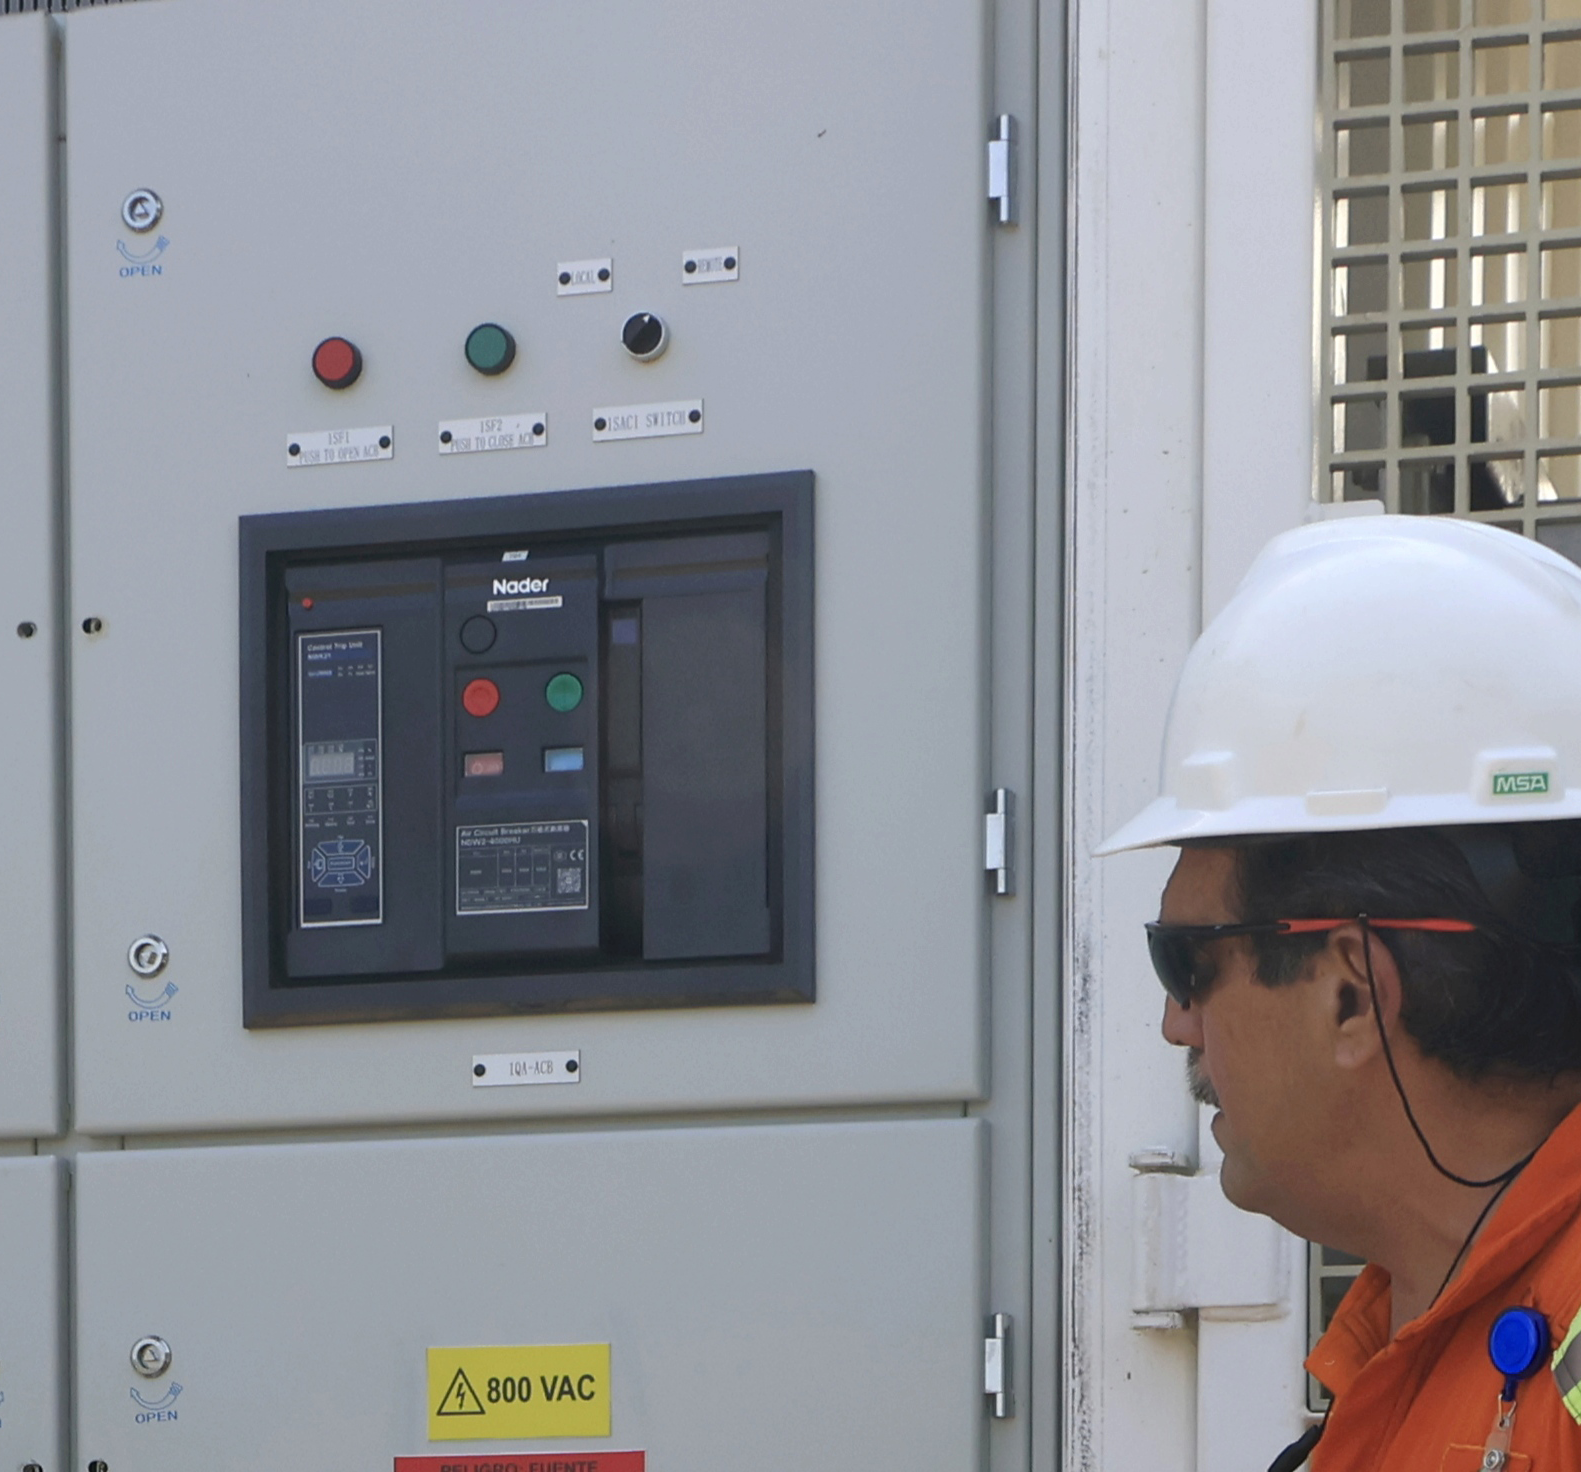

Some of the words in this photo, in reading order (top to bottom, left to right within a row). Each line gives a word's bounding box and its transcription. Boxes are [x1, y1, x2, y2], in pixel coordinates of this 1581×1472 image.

[119, 264, 162, 277] OPEN
[571, 269, 595, 285] LOCAL
[646, 411, 686, 428] SWITCH
[451, 437, 471, 452] PUSH
[476, 436, 486, 450] TO
[488, 434, 514, 448] CLOSE
[299, 449, 320, 464] PUSH
[324, 448, 335, 462] TO
[338, 446, 359, 461] OPEN
[492, 577, 550, 596] Nader
[1496, 775, 1546, 793] MSA
[473, 828, 499, 837] Circuit
[500, 826, 531, 836] Breaker
[127, 1008, 171, 1022] OPEN
[509, 1060, 554, 1077] 1QA-ACB
[487, 1376, 532, 1404] 800
[539, 1374, 596, 1402] VAC
[134, 1409, 178, 1424] OPEN
